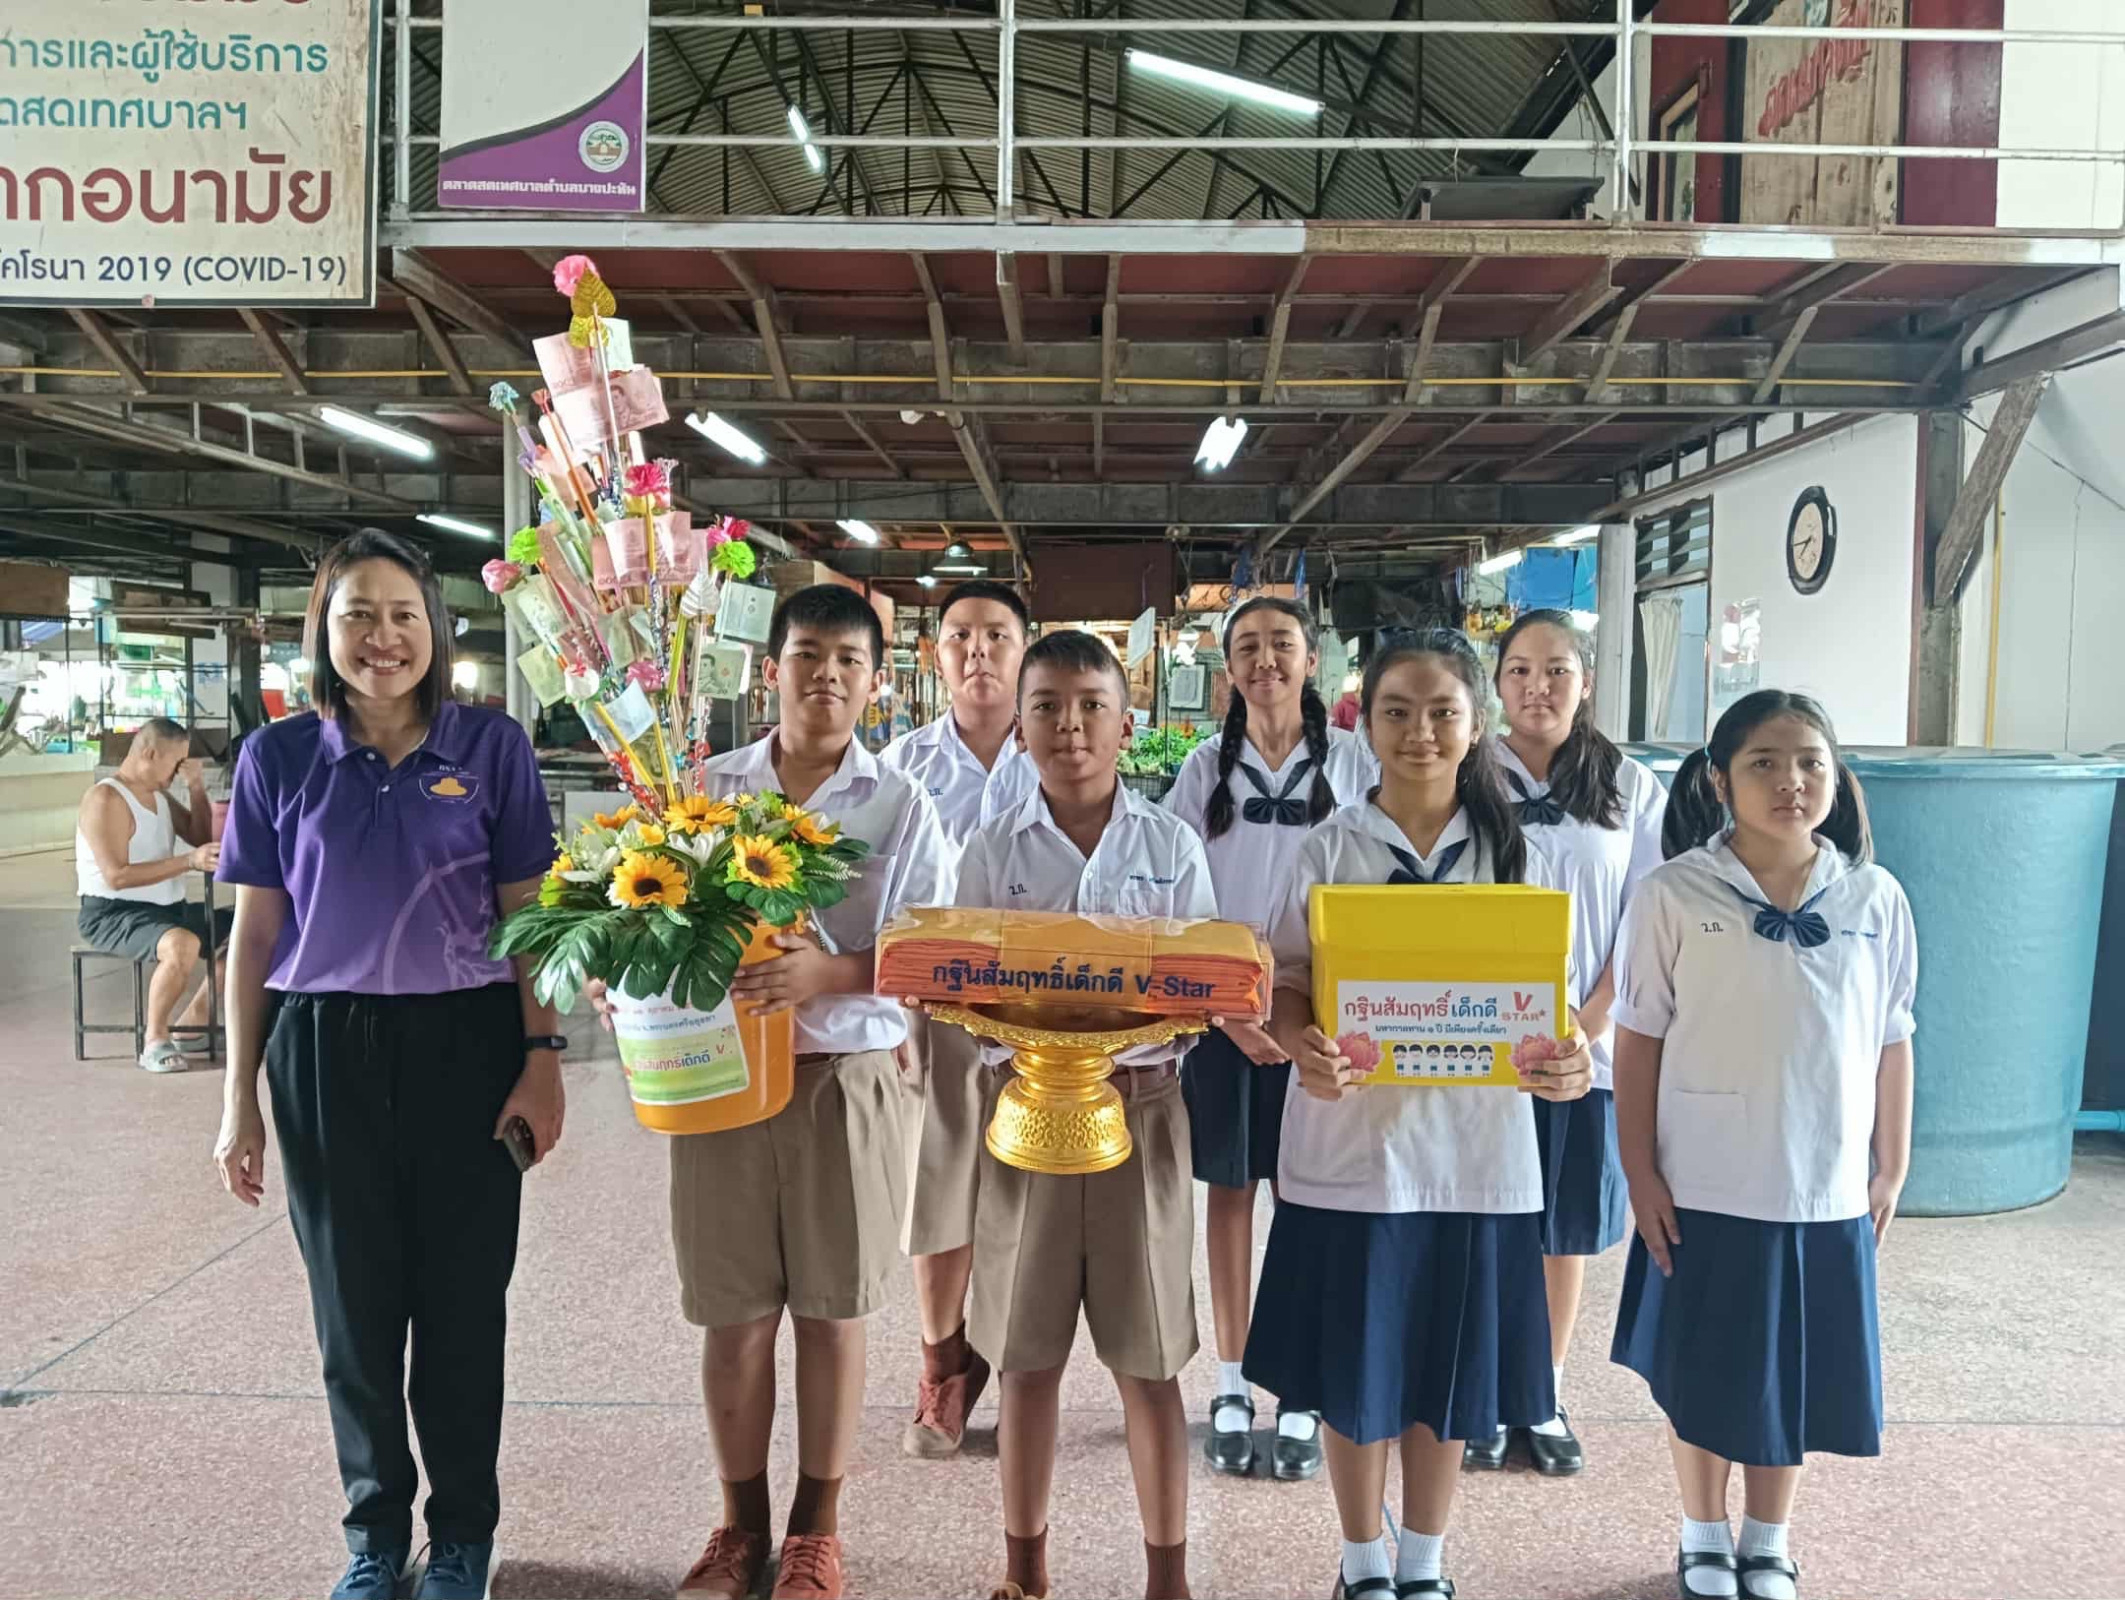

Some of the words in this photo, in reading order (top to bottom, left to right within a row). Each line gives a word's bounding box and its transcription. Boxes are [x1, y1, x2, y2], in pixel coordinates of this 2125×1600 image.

[0, 248, 85, 280] คโรนา
[98, 256, 171, 281] 2019
[183, 256, 347, 286] (COVID-19)
[1136, 974, 1215, 998] V-Star
[1501, 1012, 1540, 1021] STAR
